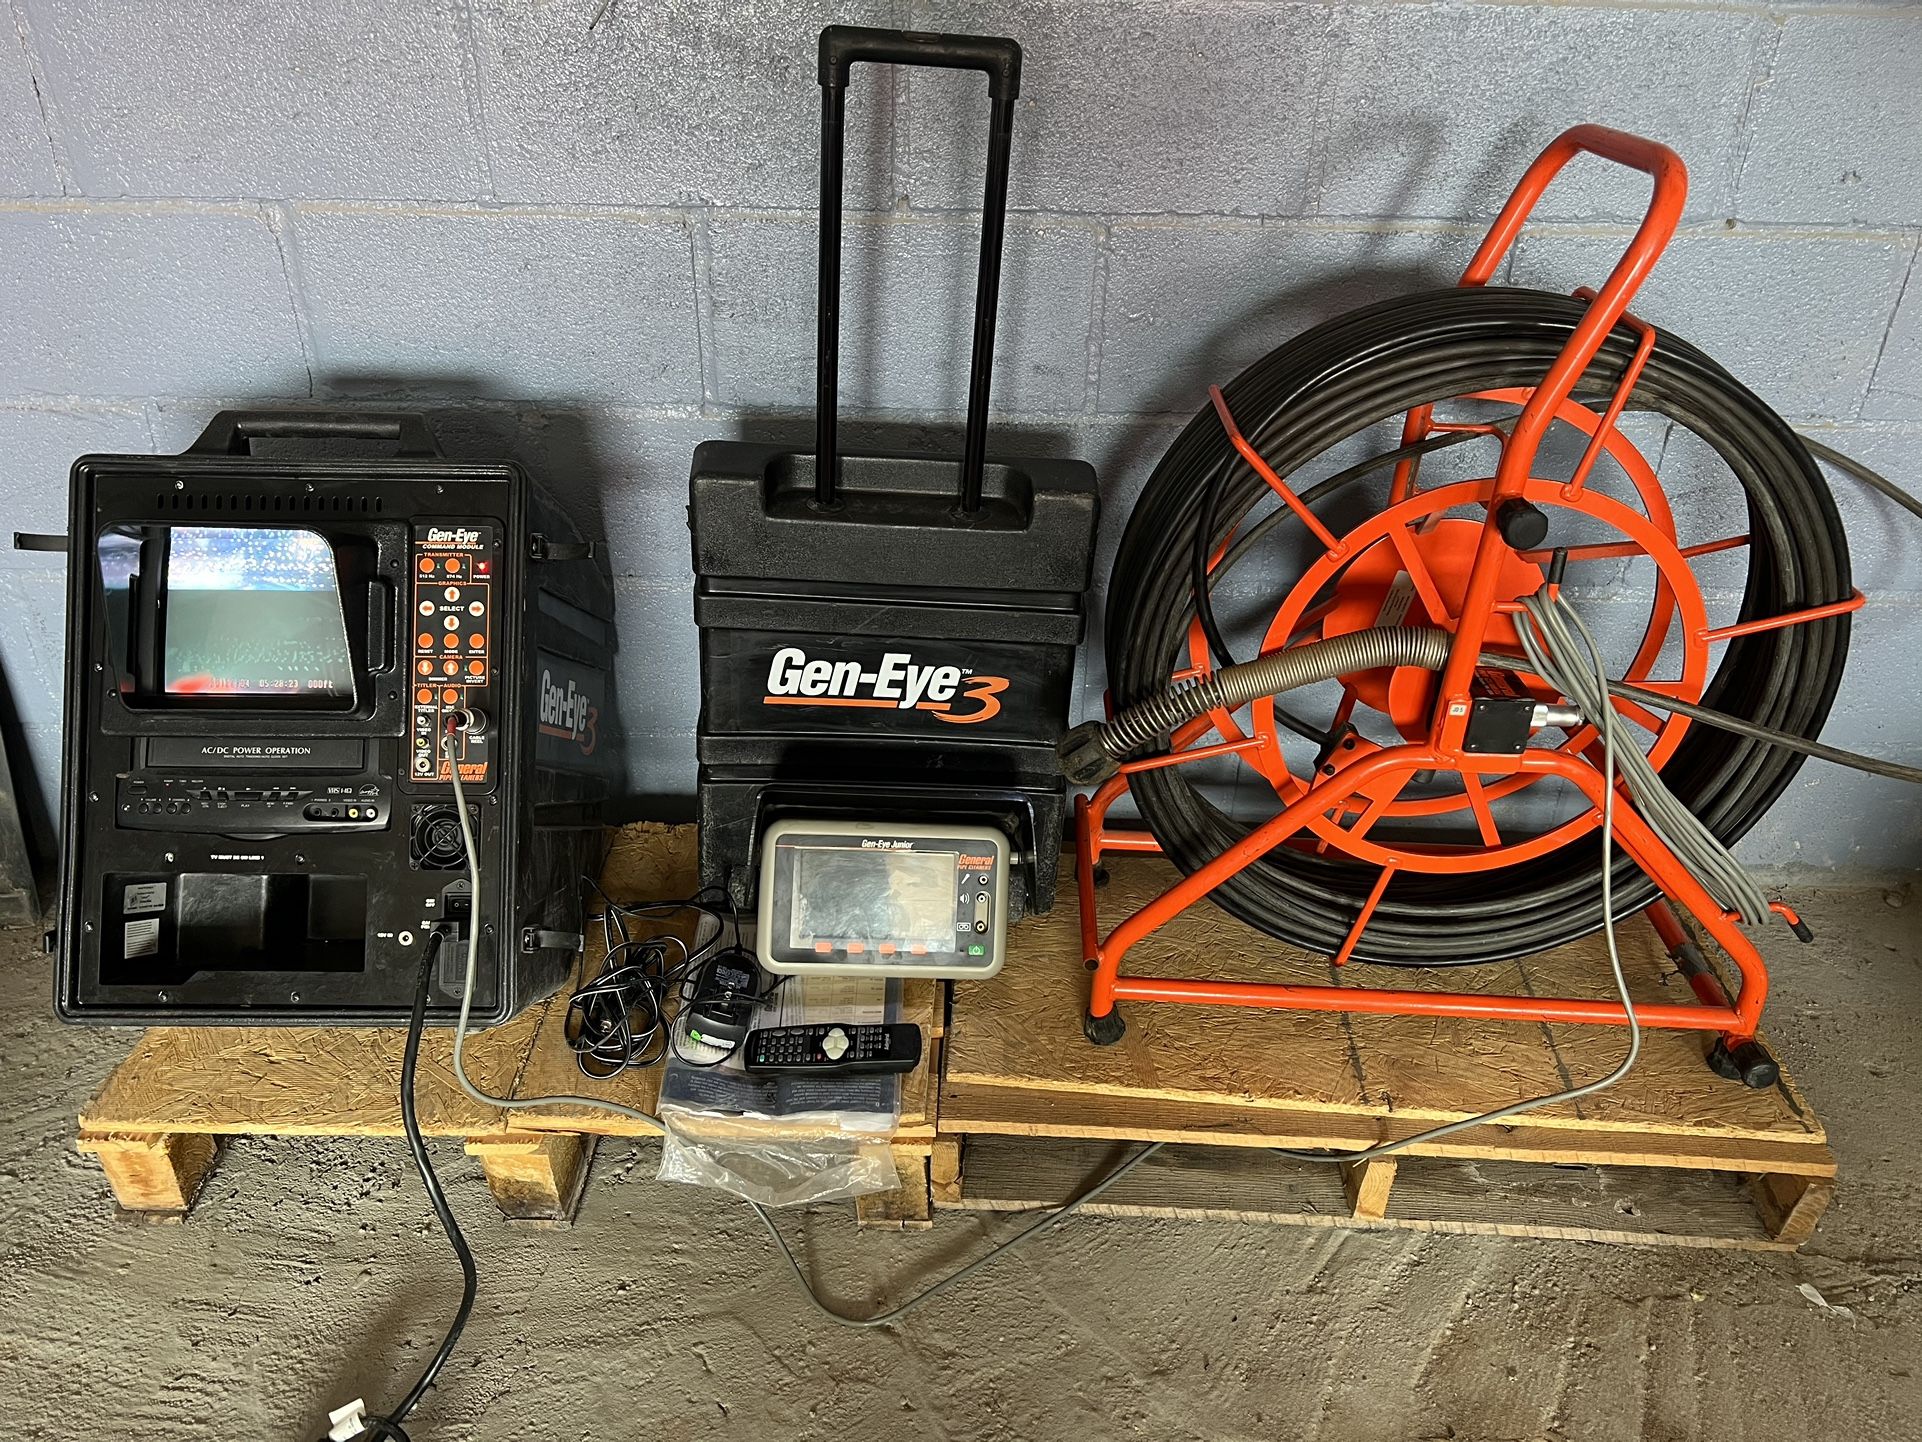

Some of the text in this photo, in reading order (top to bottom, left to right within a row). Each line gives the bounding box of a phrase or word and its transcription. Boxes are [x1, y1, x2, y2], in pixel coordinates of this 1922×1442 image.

[932, 676, 1010, 723] 3
[861, 839, 914, 849] Gen-Eye Junior
[958, 854, 994, 865] General
